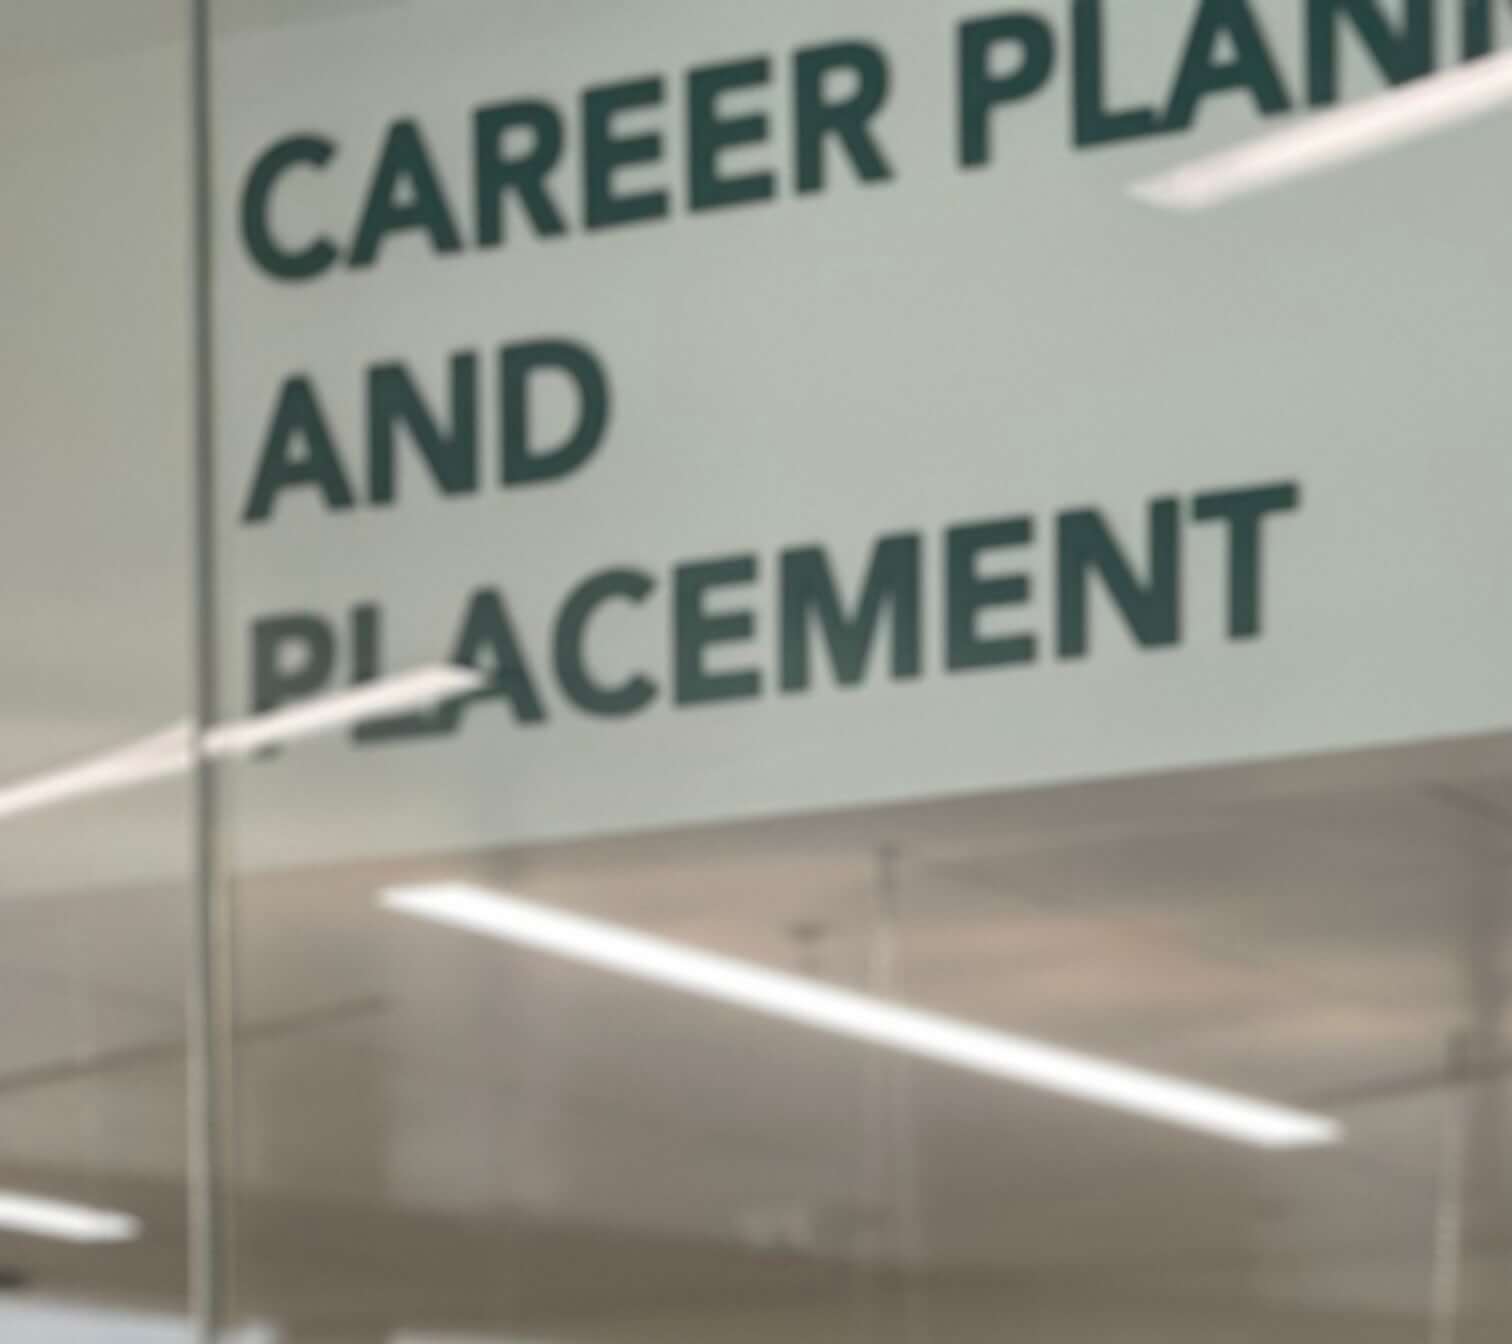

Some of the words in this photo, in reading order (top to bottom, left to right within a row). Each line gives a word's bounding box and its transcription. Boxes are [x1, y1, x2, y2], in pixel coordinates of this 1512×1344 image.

[240, 39, 894, 284] CAREER
[242, 337, 612, 525] AND
[250, 480, 1302, 758] PLACEMENT
